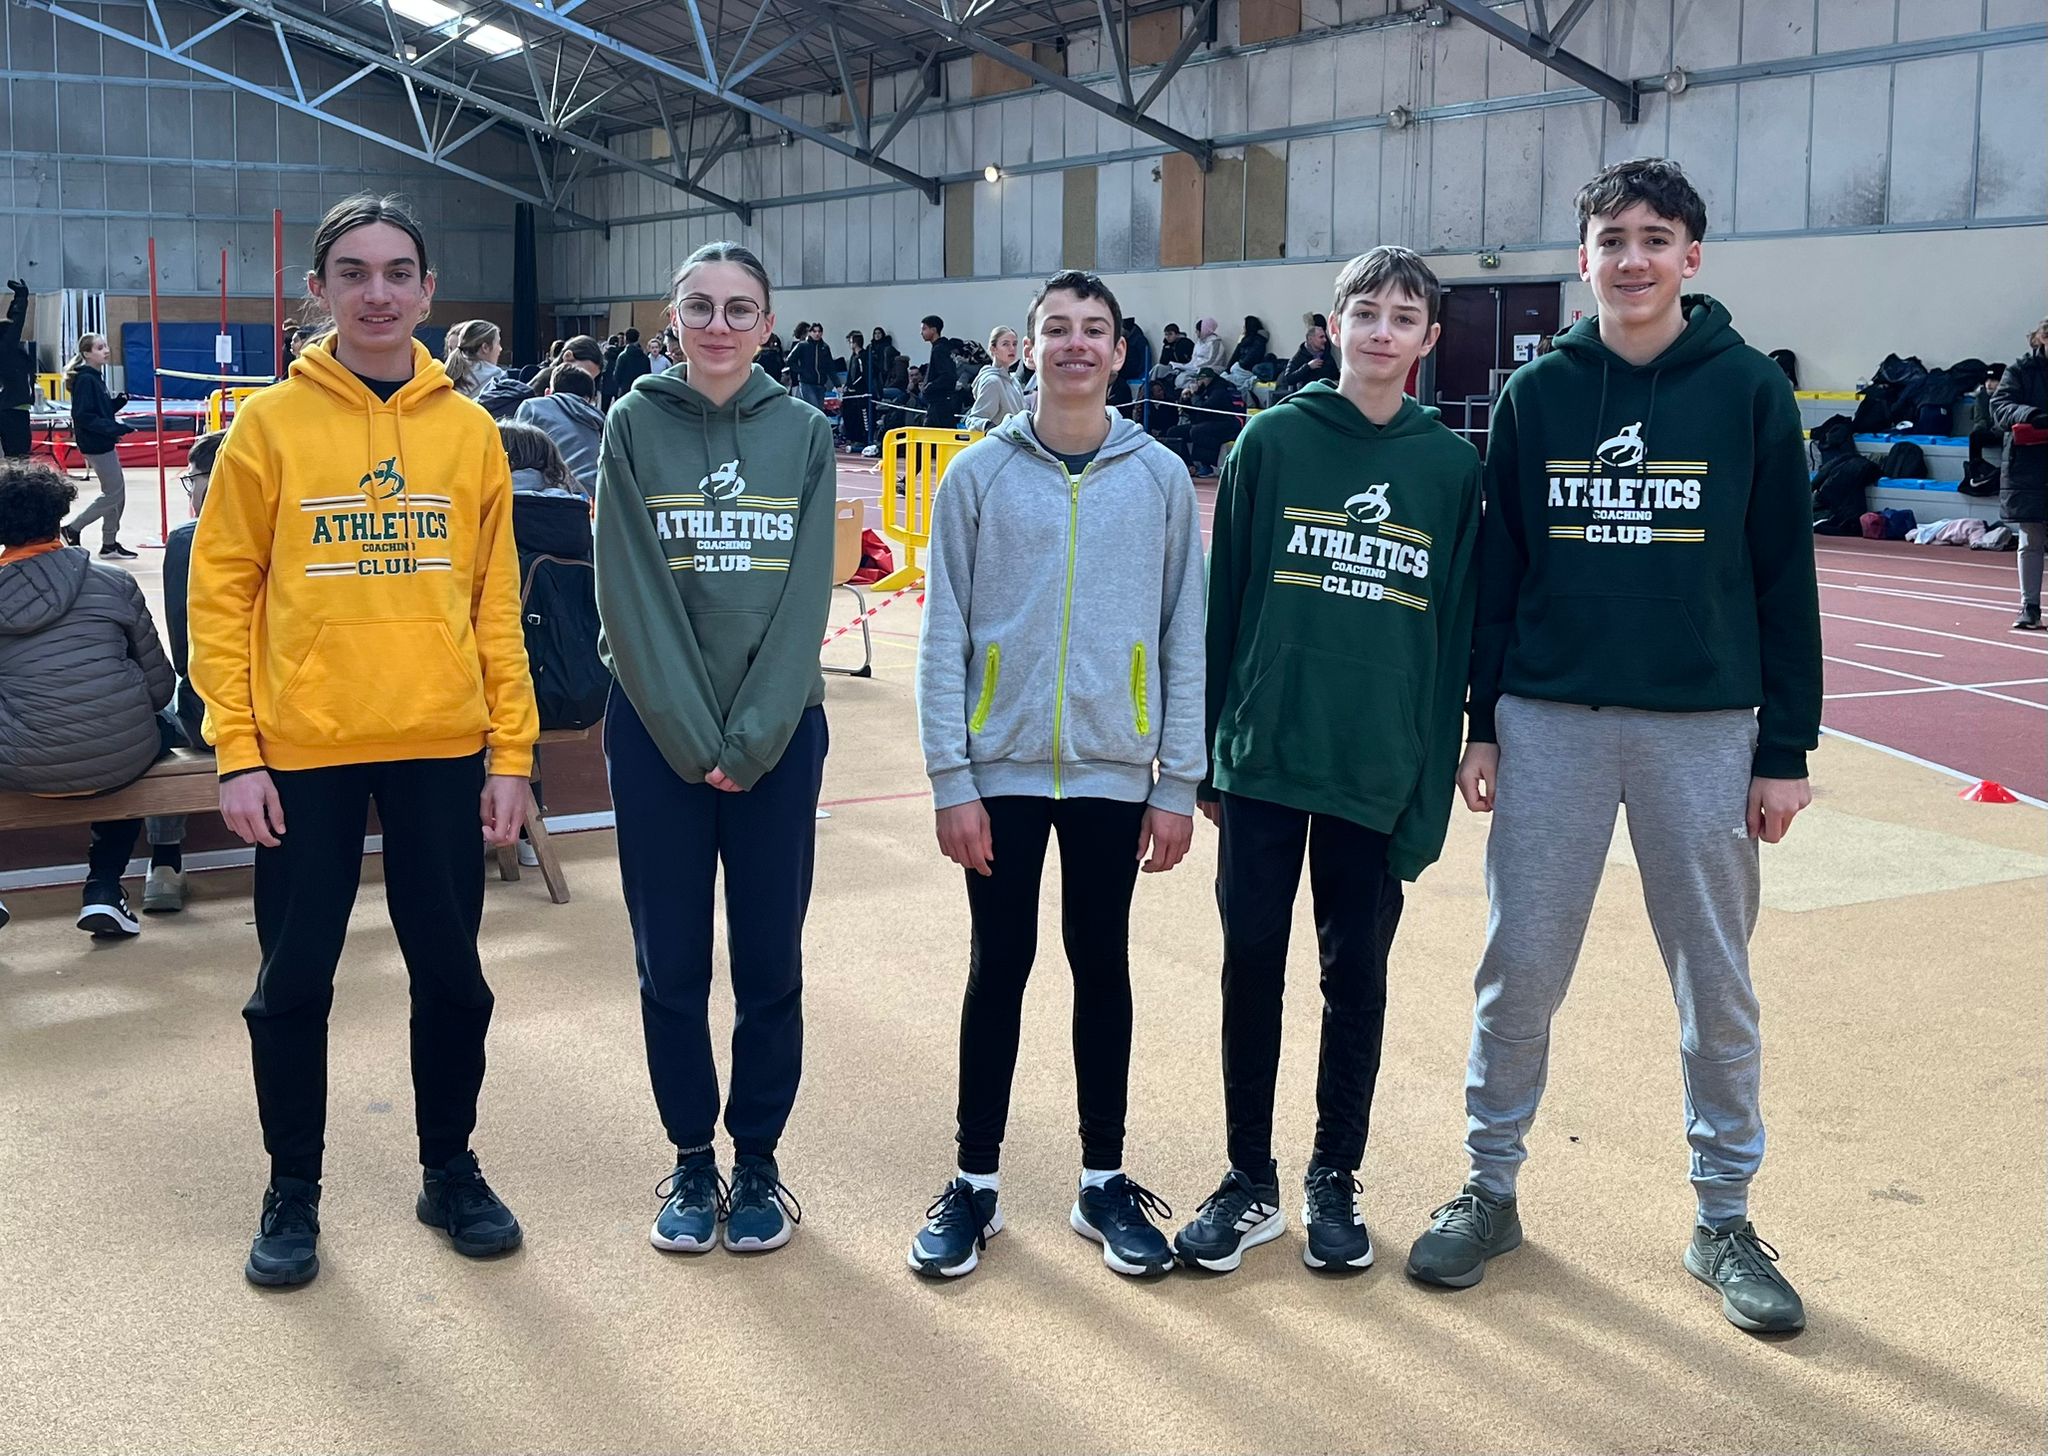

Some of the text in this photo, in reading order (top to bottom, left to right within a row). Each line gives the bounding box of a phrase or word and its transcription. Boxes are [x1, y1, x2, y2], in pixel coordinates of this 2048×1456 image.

[1547, 477, 1701, 509] ATHLETICS
[656, 510, 794, 541] ATHLETICS
[1592, 510, 1653, 521] COACHING
[312, 511, 448, 544] ATHLETICS
[1585, 525, 1653, 544] CLUB
[696, 540, 751, 550] COACHING
[1287, 524, 1429, 579] ATHLETICS
[693, 555, 752, 572] CLUB
[1331, 561, 1387, 579] COACHING
[1322, 575, 1385, 601] CLUB
